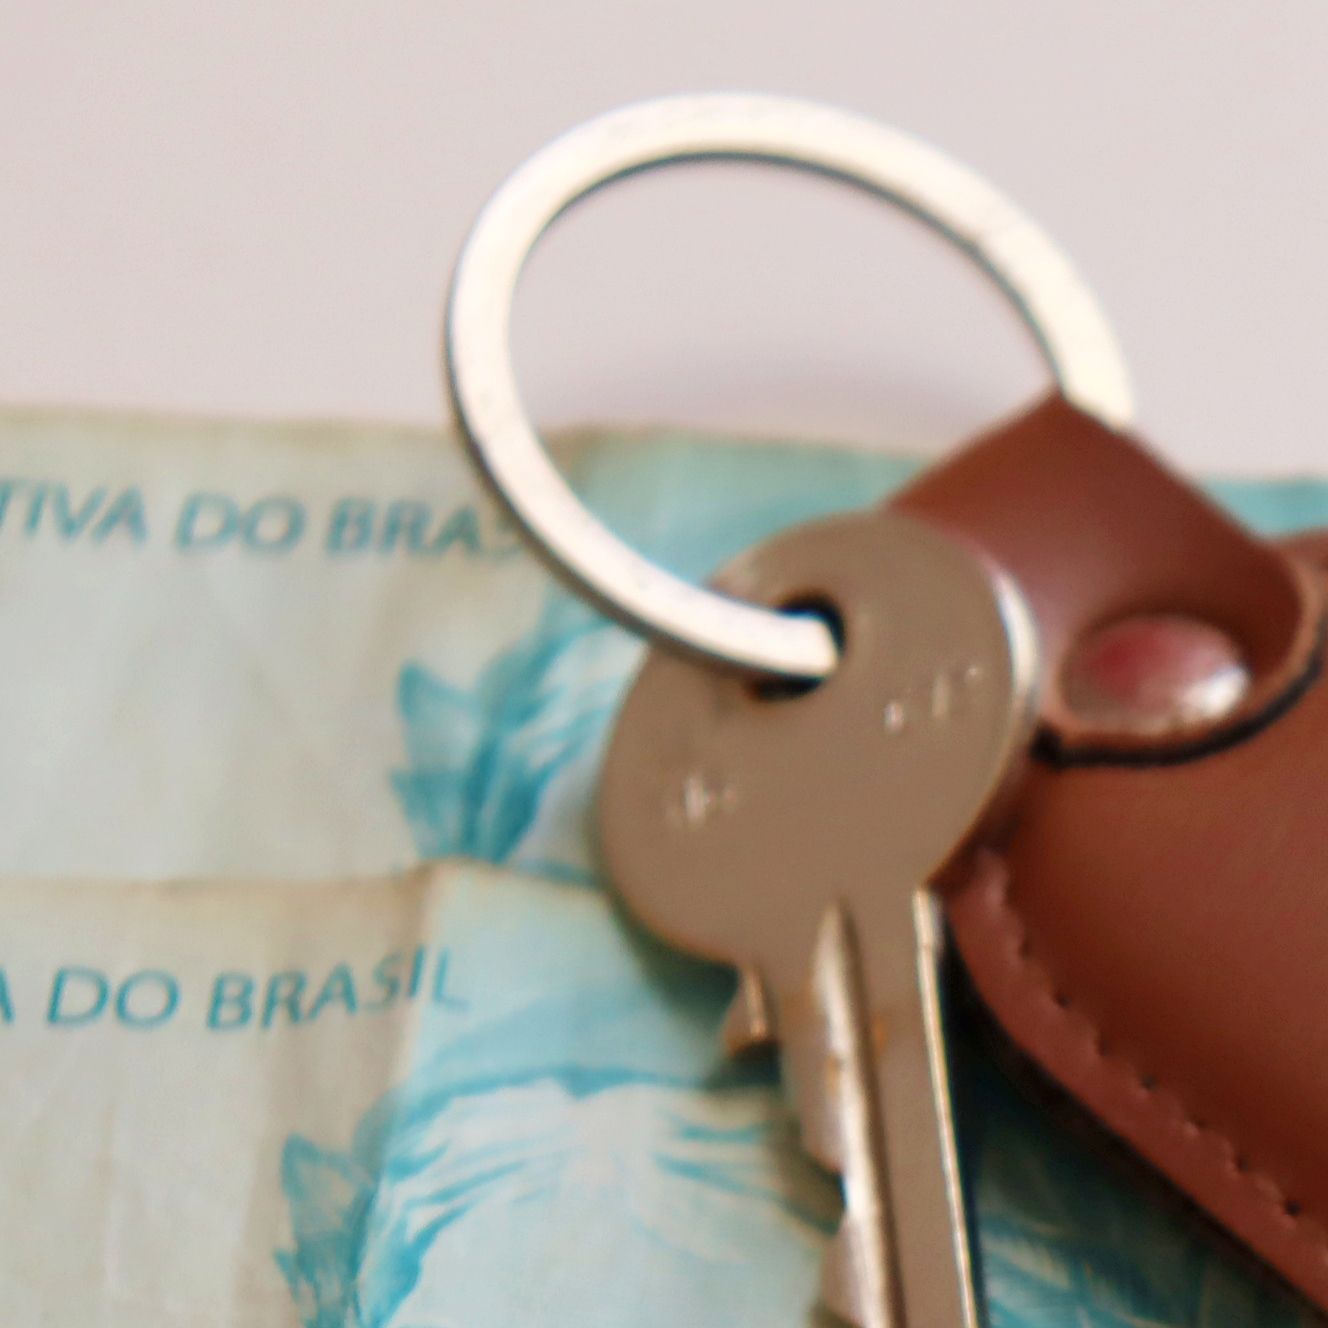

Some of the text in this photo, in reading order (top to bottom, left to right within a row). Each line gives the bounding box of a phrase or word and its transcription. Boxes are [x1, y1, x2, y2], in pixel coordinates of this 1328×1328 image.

[175, 490, 306, 556] DO
[48, 966, 181, 1029] DO
[207, 945, 470, 1032] BRASIL
